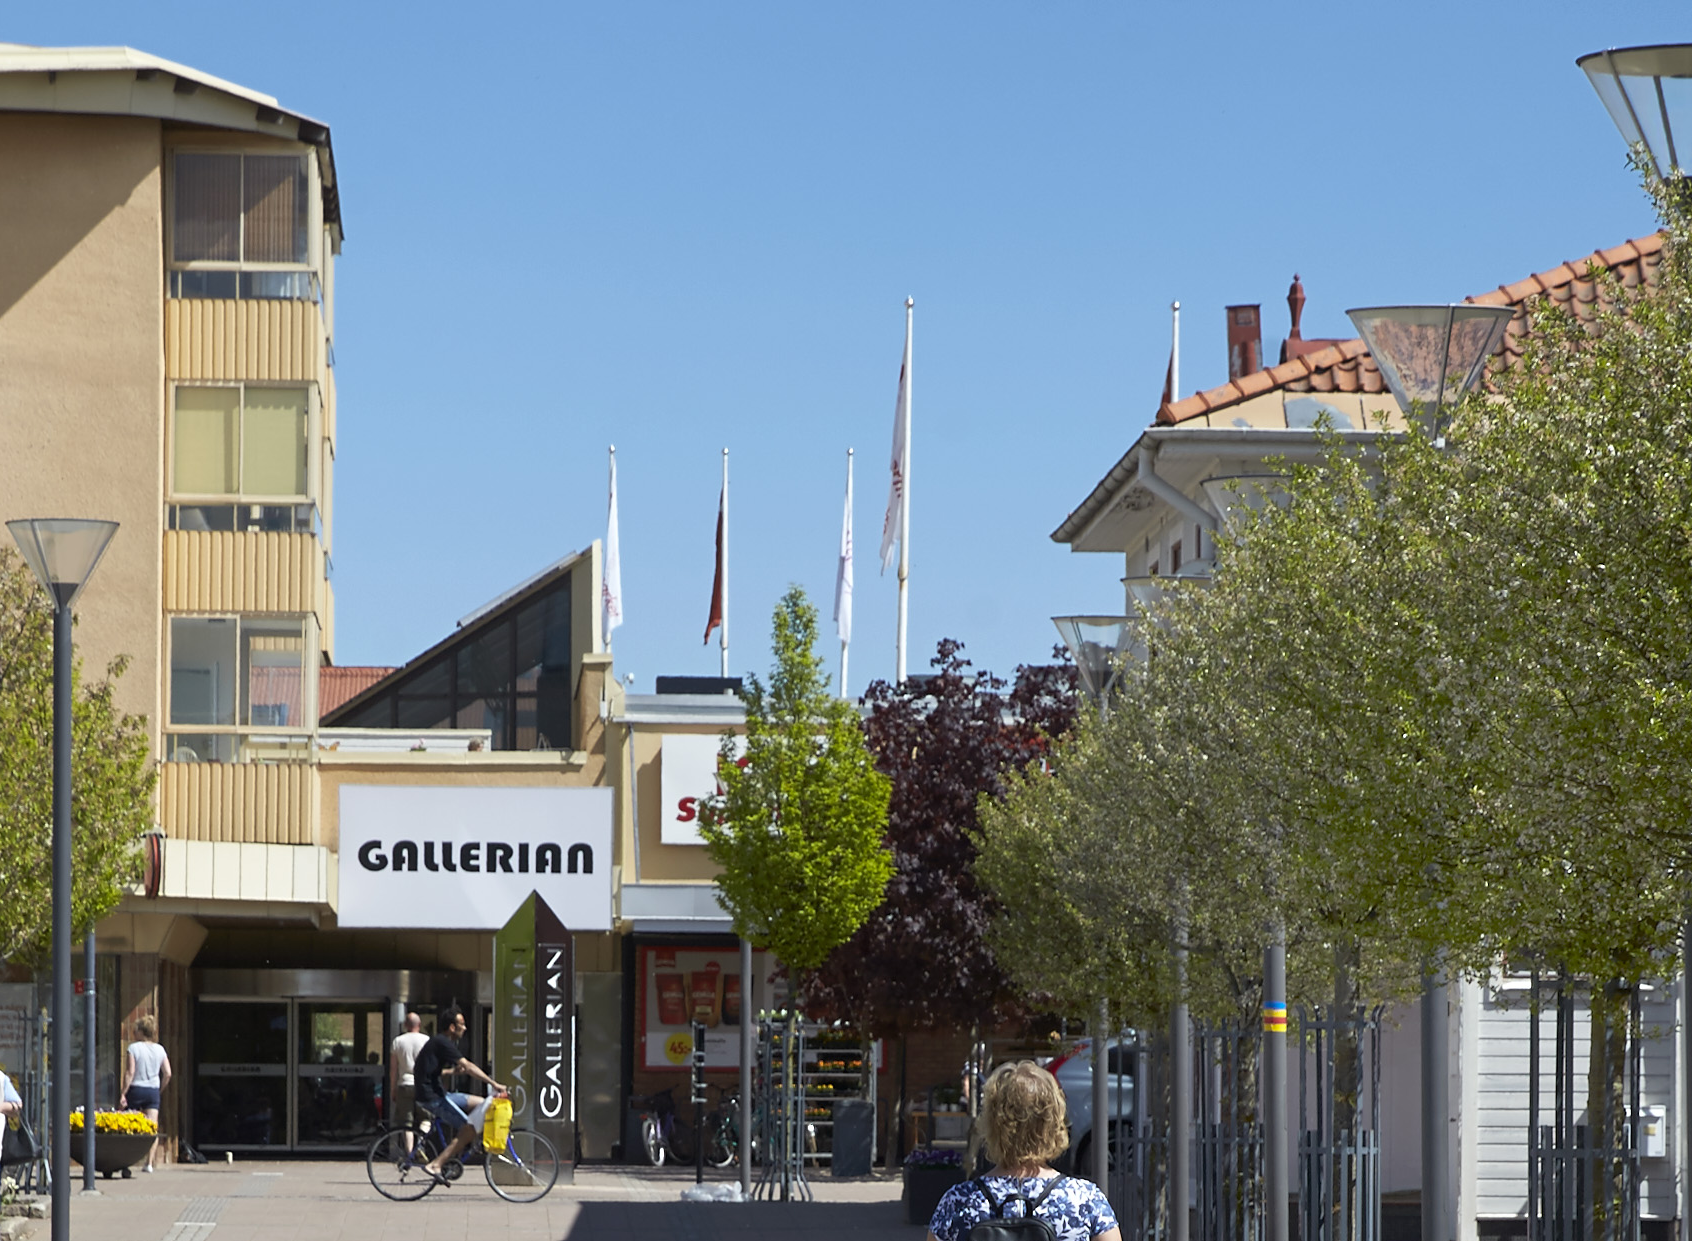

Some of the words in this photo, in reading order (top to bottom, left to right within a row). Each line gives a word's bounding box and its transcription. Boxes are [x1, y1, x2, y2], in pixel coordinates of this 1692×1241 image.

[358, 840, 594, 875] GALLERIAN
[510, 947, 527, 1117] GALLERIAN
[539, 947, 564, 1118] GALLERIAN
